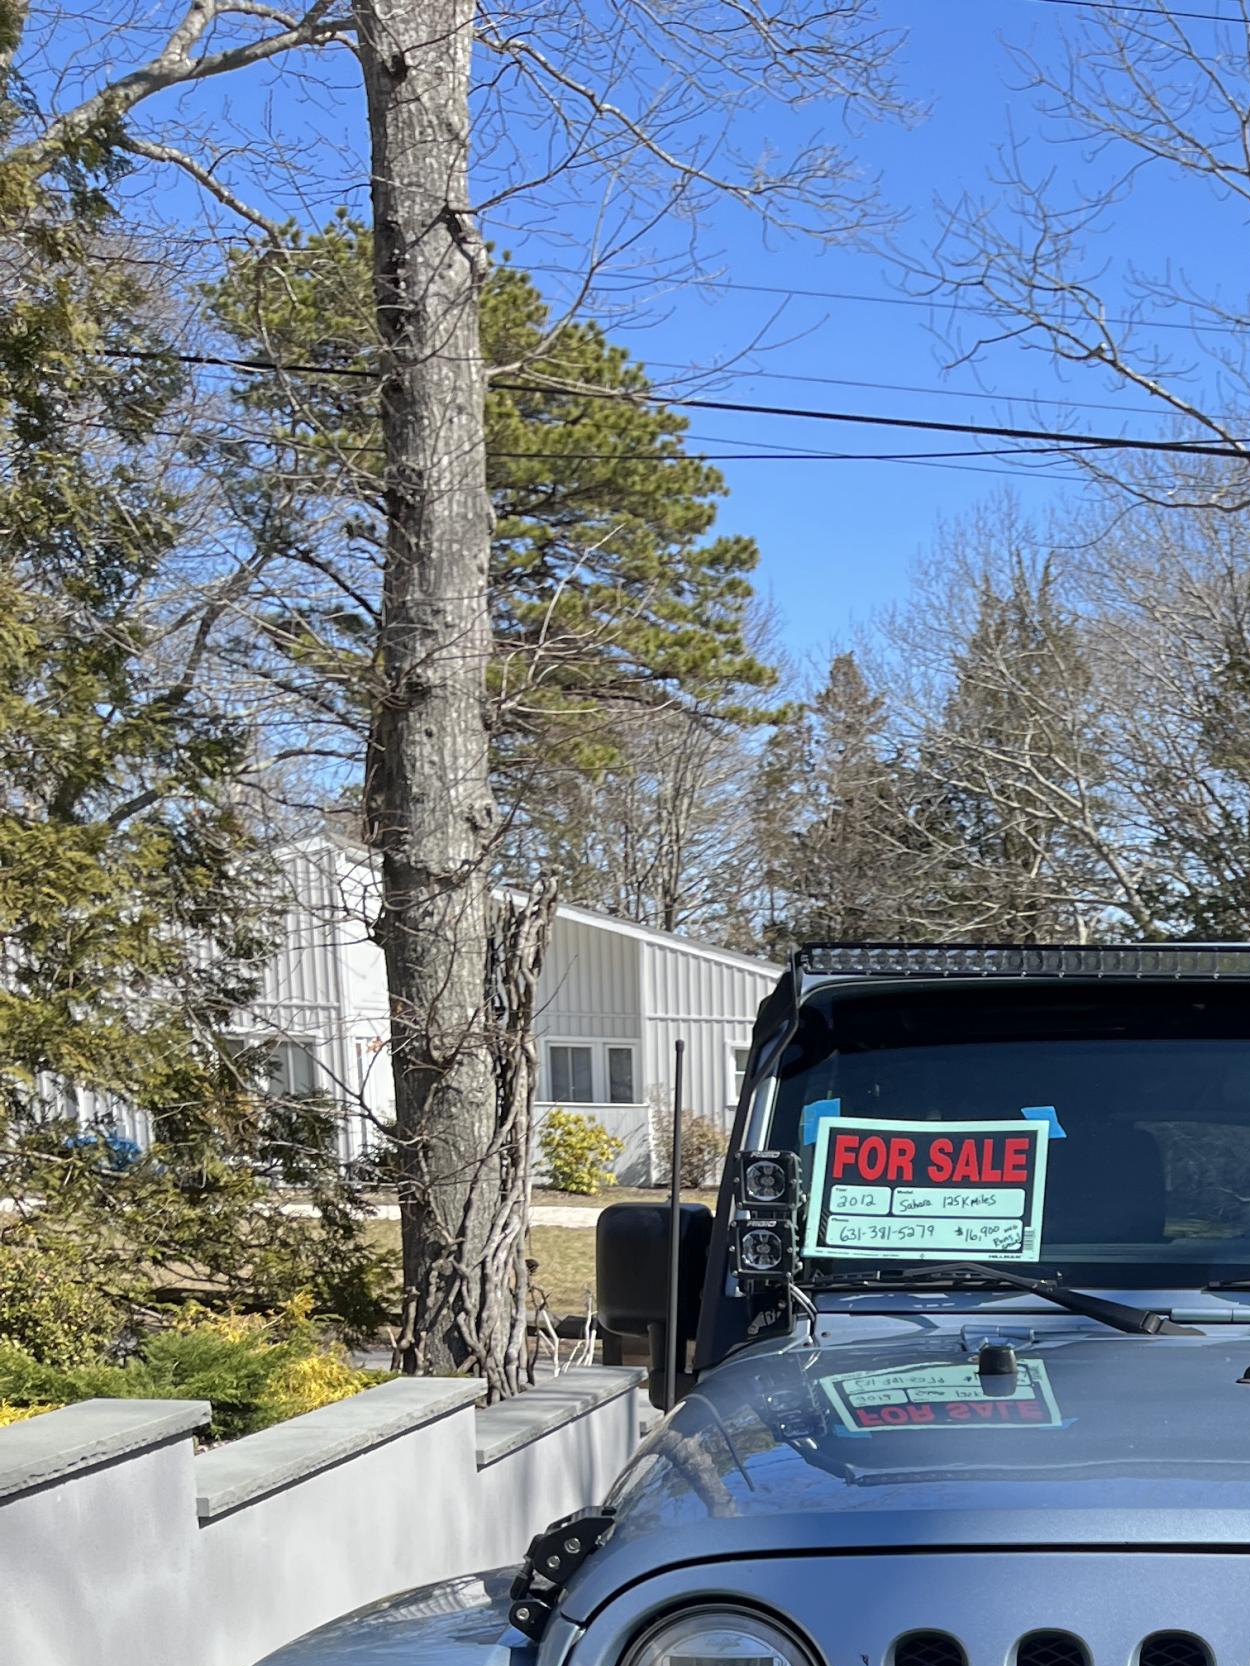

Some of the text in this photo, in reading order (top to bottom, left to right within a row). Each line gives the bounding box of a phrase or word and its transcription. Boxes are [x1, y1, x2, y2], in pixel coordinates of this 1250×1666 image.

[832, 1135, 1029, 1183] FOR SALE
[836, 1194, 876, 1208] 2012
